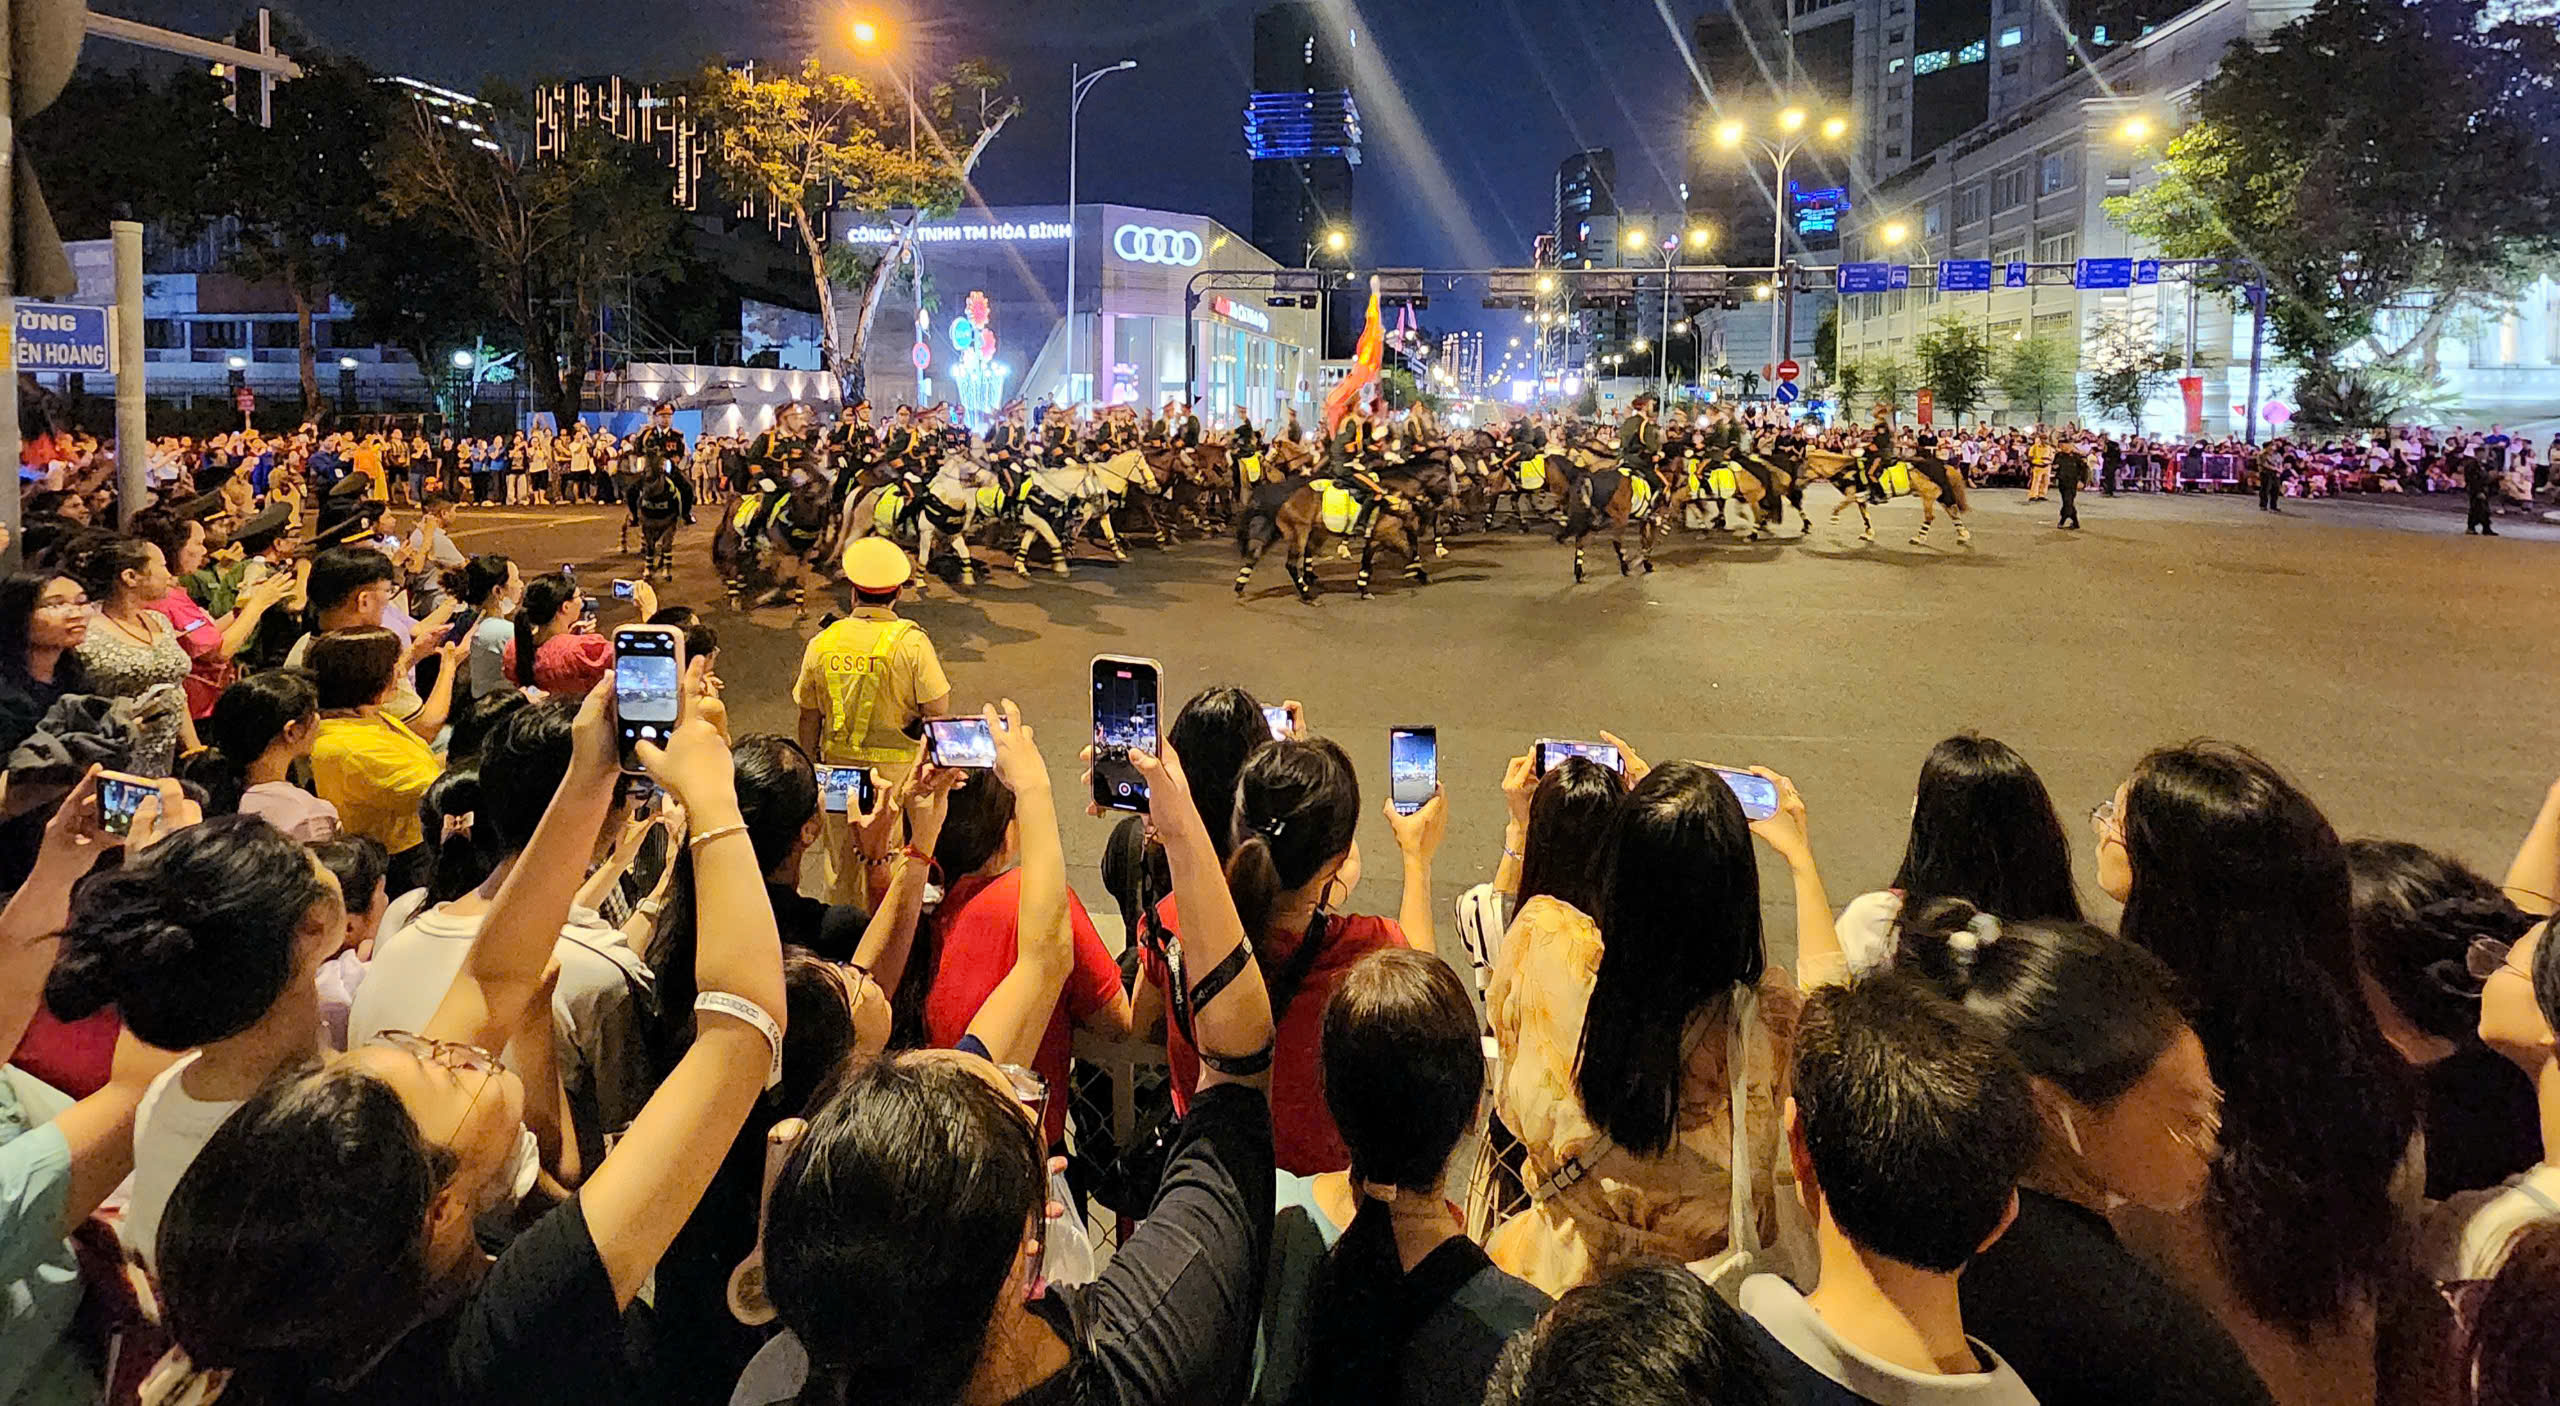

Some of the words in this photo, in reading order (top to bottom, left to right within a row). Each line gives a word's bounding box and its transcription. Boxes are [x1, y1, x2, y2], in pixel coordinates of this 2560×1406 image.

[917, 226, 962, 241] TNHH
[962, 224, 988, 241] TM
[1028, 221, 1073, 240] BÌNH
[830, 655, 878, 673] CSGT
